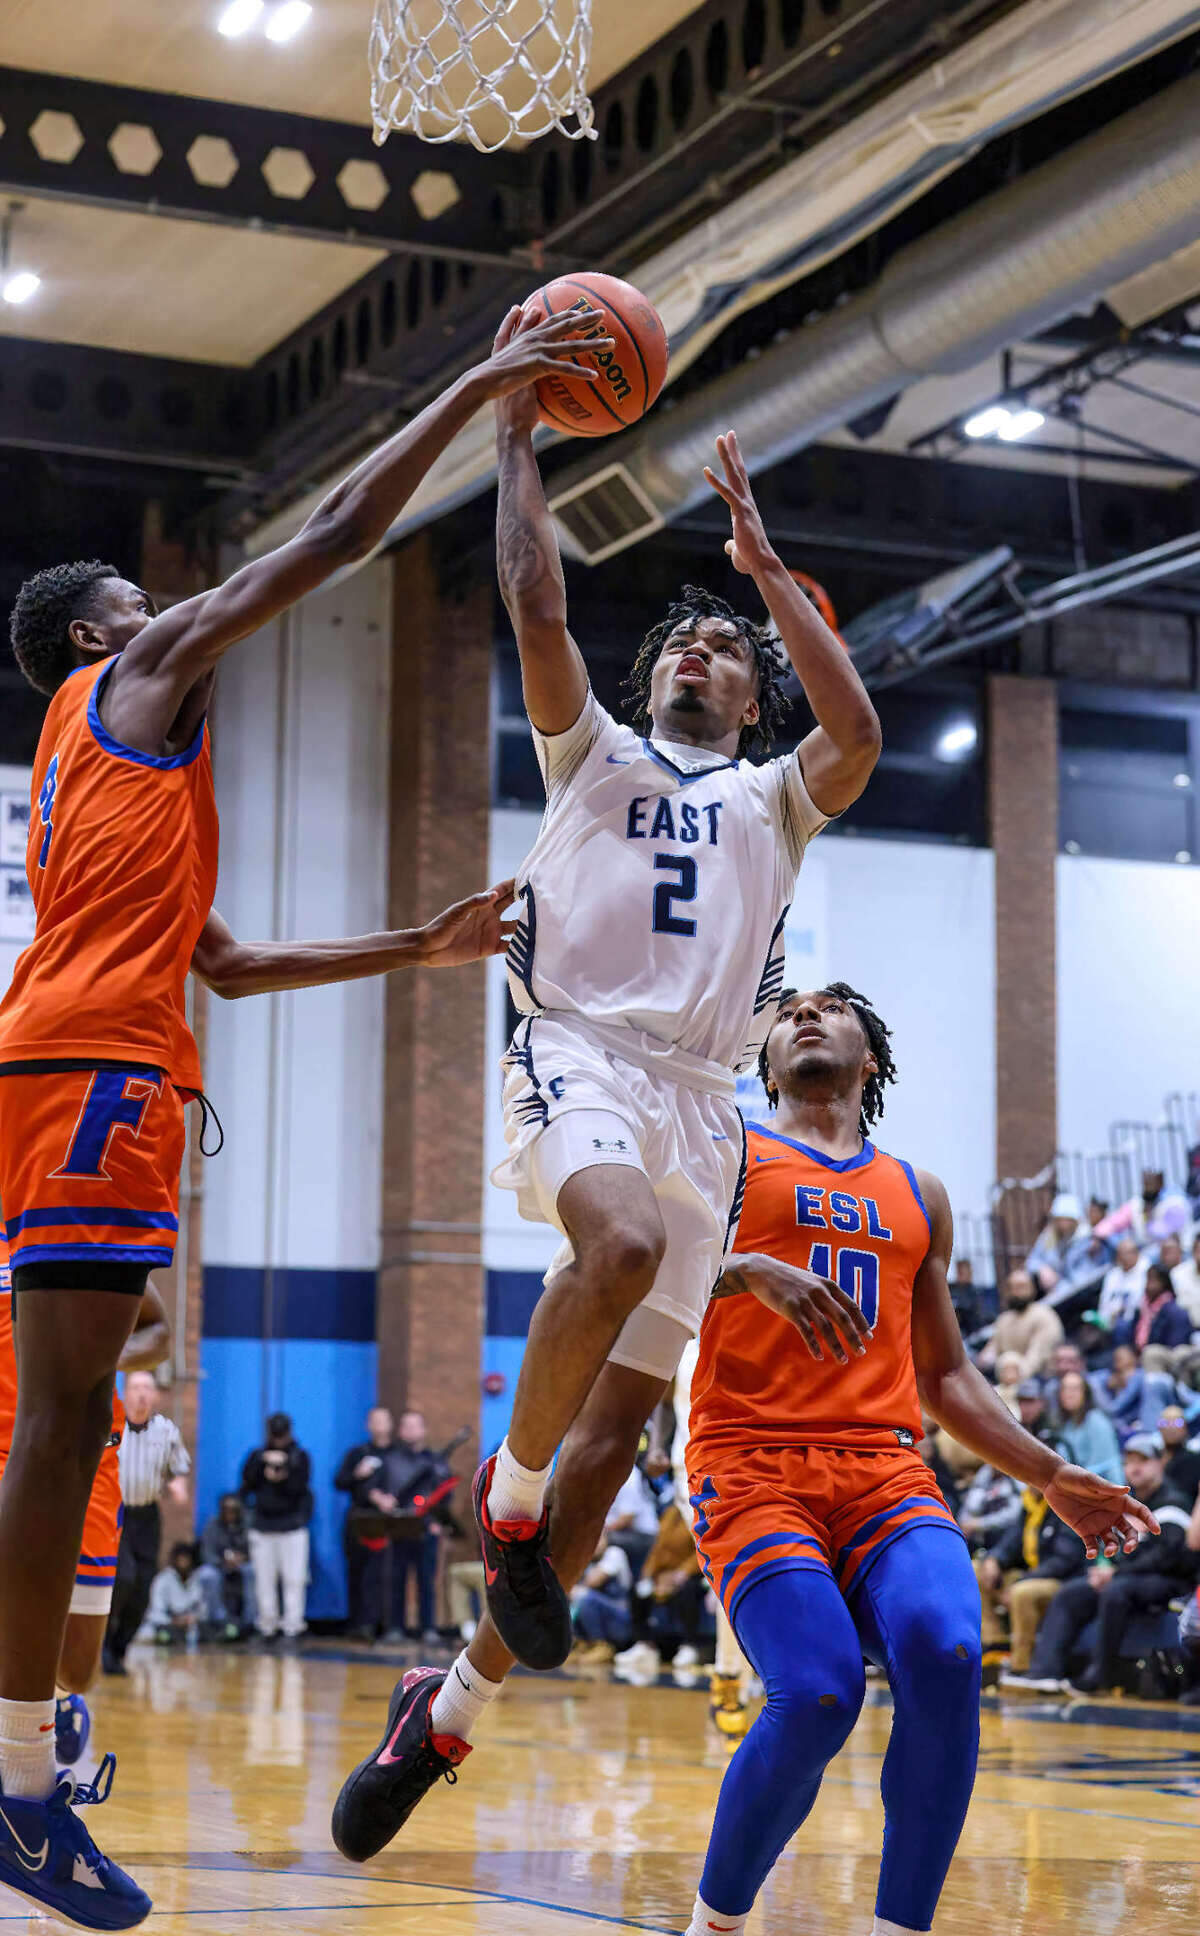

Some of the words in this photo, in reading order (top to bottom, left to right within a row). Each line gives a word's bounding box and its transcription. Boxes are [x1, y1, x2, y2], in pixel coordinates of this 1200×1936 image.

[568, 296, 632, 403] Wison
[626, 796, 724, 846] EAST
[652, 852, 698, 938] 2
[46, 1070, 165, 1181] F
[795, 1184, 893, 1241] ESL
